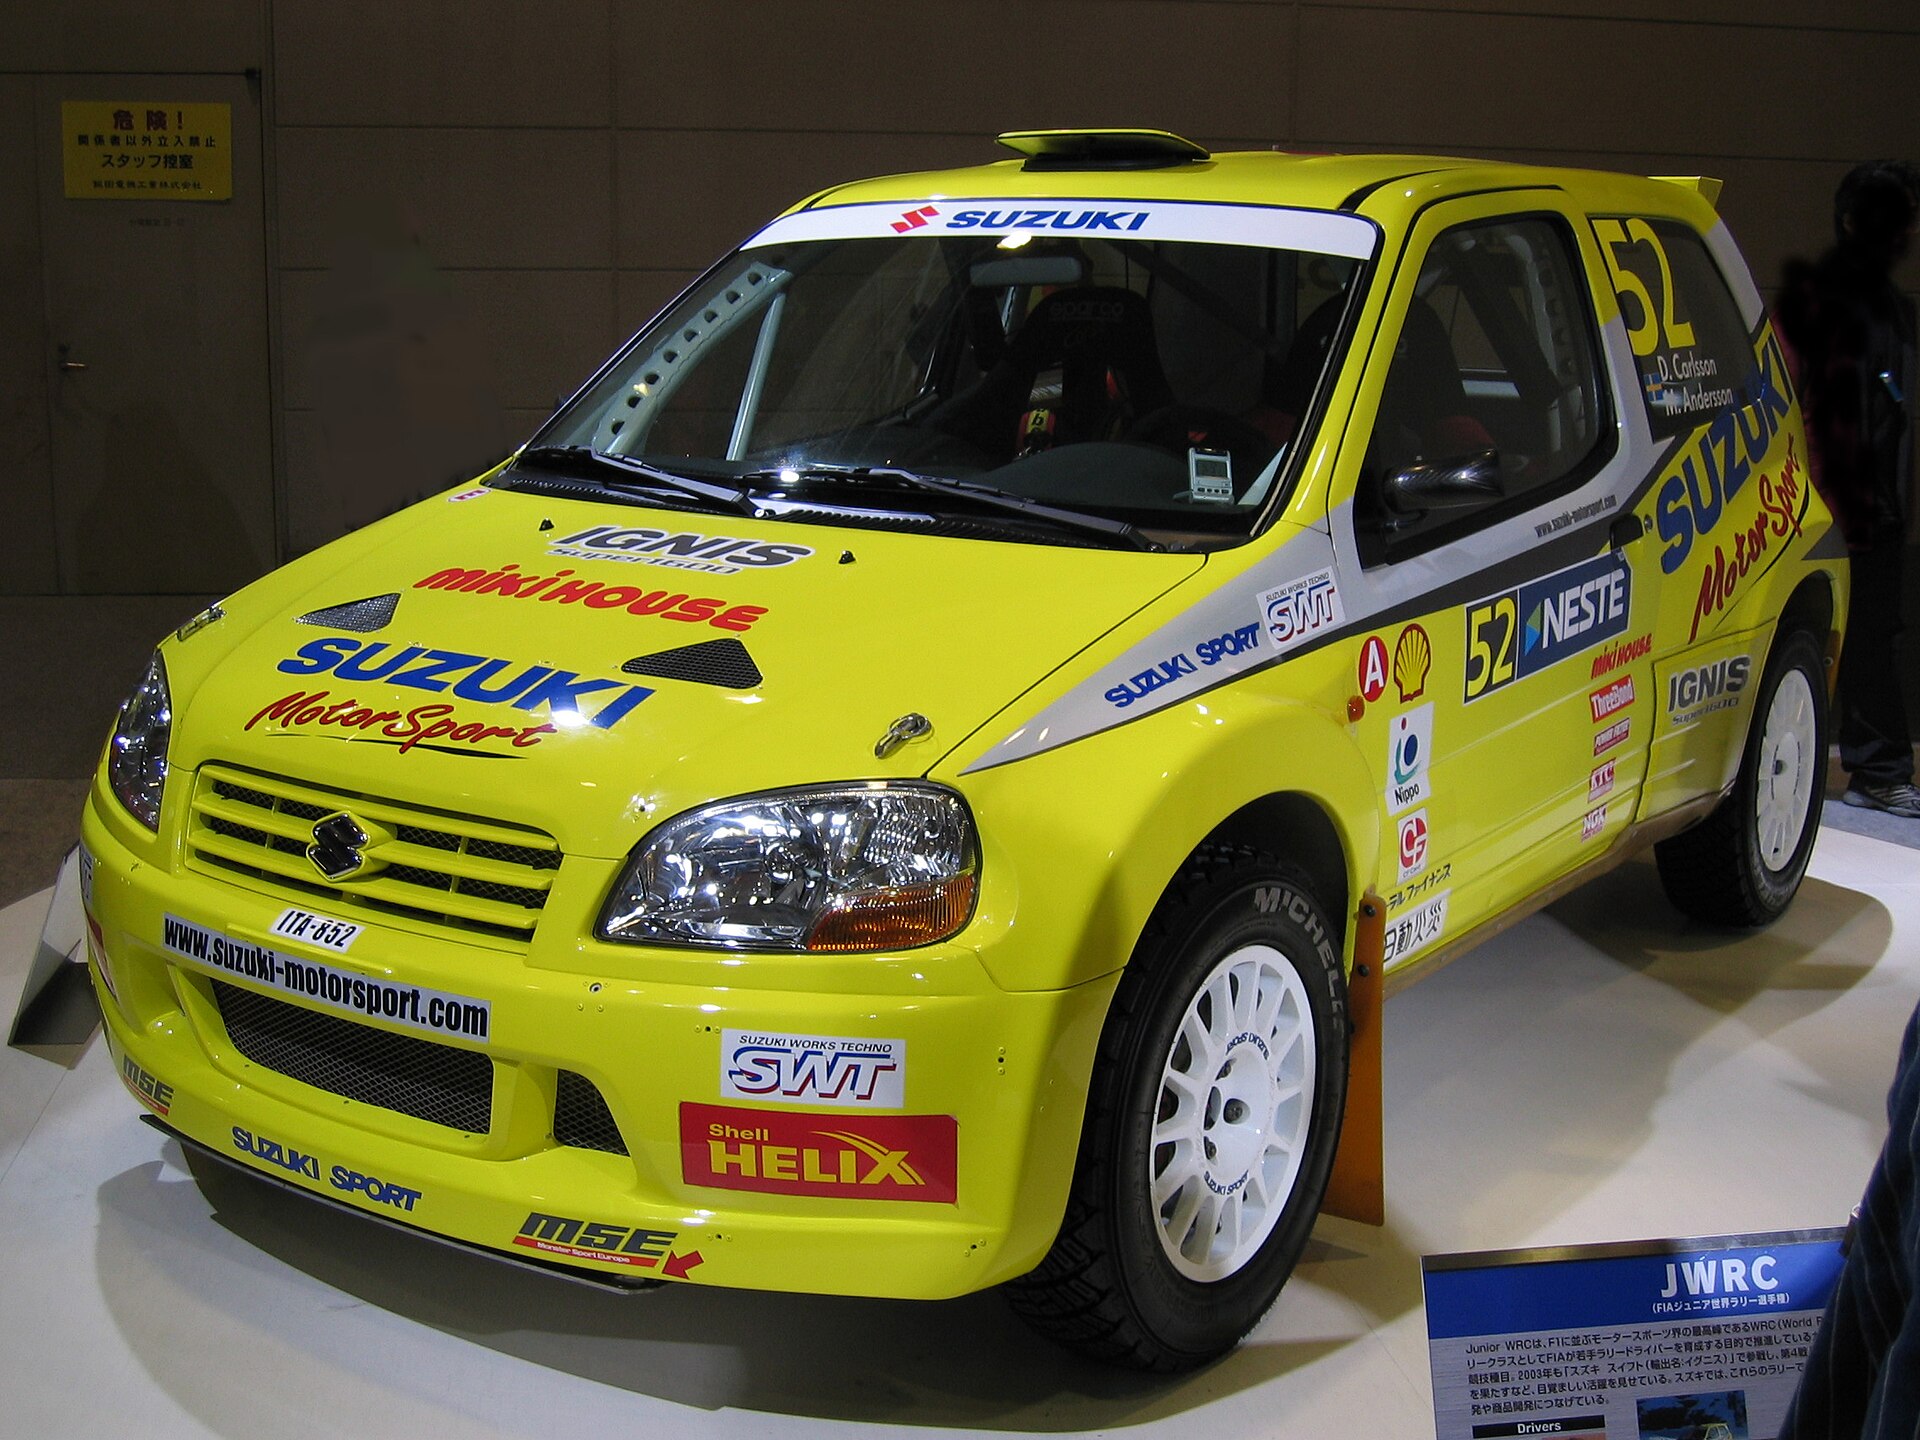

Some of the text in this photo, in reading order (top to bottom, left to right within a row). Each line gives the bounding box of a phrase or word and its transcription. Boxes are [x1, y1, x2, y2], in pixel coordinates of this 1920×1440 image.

[113, 110, 183, 130] 危険!
[78, 134, 216, 147] 関係者以外立入禁止
[102, 154, 194, 169] スタッフ控室
[946, 210, 1150, 231] SUZUKI
[1592, 218, 1696, 356] 52
[1657, 351, 1717, 382] D. Carlsson
[1683, 382, 1734, 413] Andersson
[1657, 332, 1794, 574] SUZUKI
[550, 548, 740, 574] Super1600
[554, 526, 813, 566] IGNIS
[1267, 580, 1335, 642] SWT
[1542, 568, 1626, 648] NESTE
[1104, 622, 1260, 707] SUZUKI SPORT
[1363, 639, 1386, 694] A
[1467, 597, 1516, 697] 52
[277, 637, 657, 730] SUZUKI
[1668, 655, 1750, 713] IGNIS
[1394, 783, 1420, 806] Nippo
[277, 910, 357, 947] ITA-852
[164, 918, 488, 1037] www.suzuki-motorsport.com
[740, 1035, 893, 1053] SUZUKI WORKS TECHNO
[728, 1046, 896, 1100] SWT
[709, 1123, 769, 1141] Shell
[232, 1126, 422, 1212] SUZUKI SPORT
[707, 1136, 925, 1186] HELIX
[1660, 1255, 1779, 1298] JWRC
[1466, 1342, 1500, 1354] Junior
[1472, 1394, 1609, 1416] 発や商品開発につなげている。
[1517, 1422, 1561, 1434] Drivers
